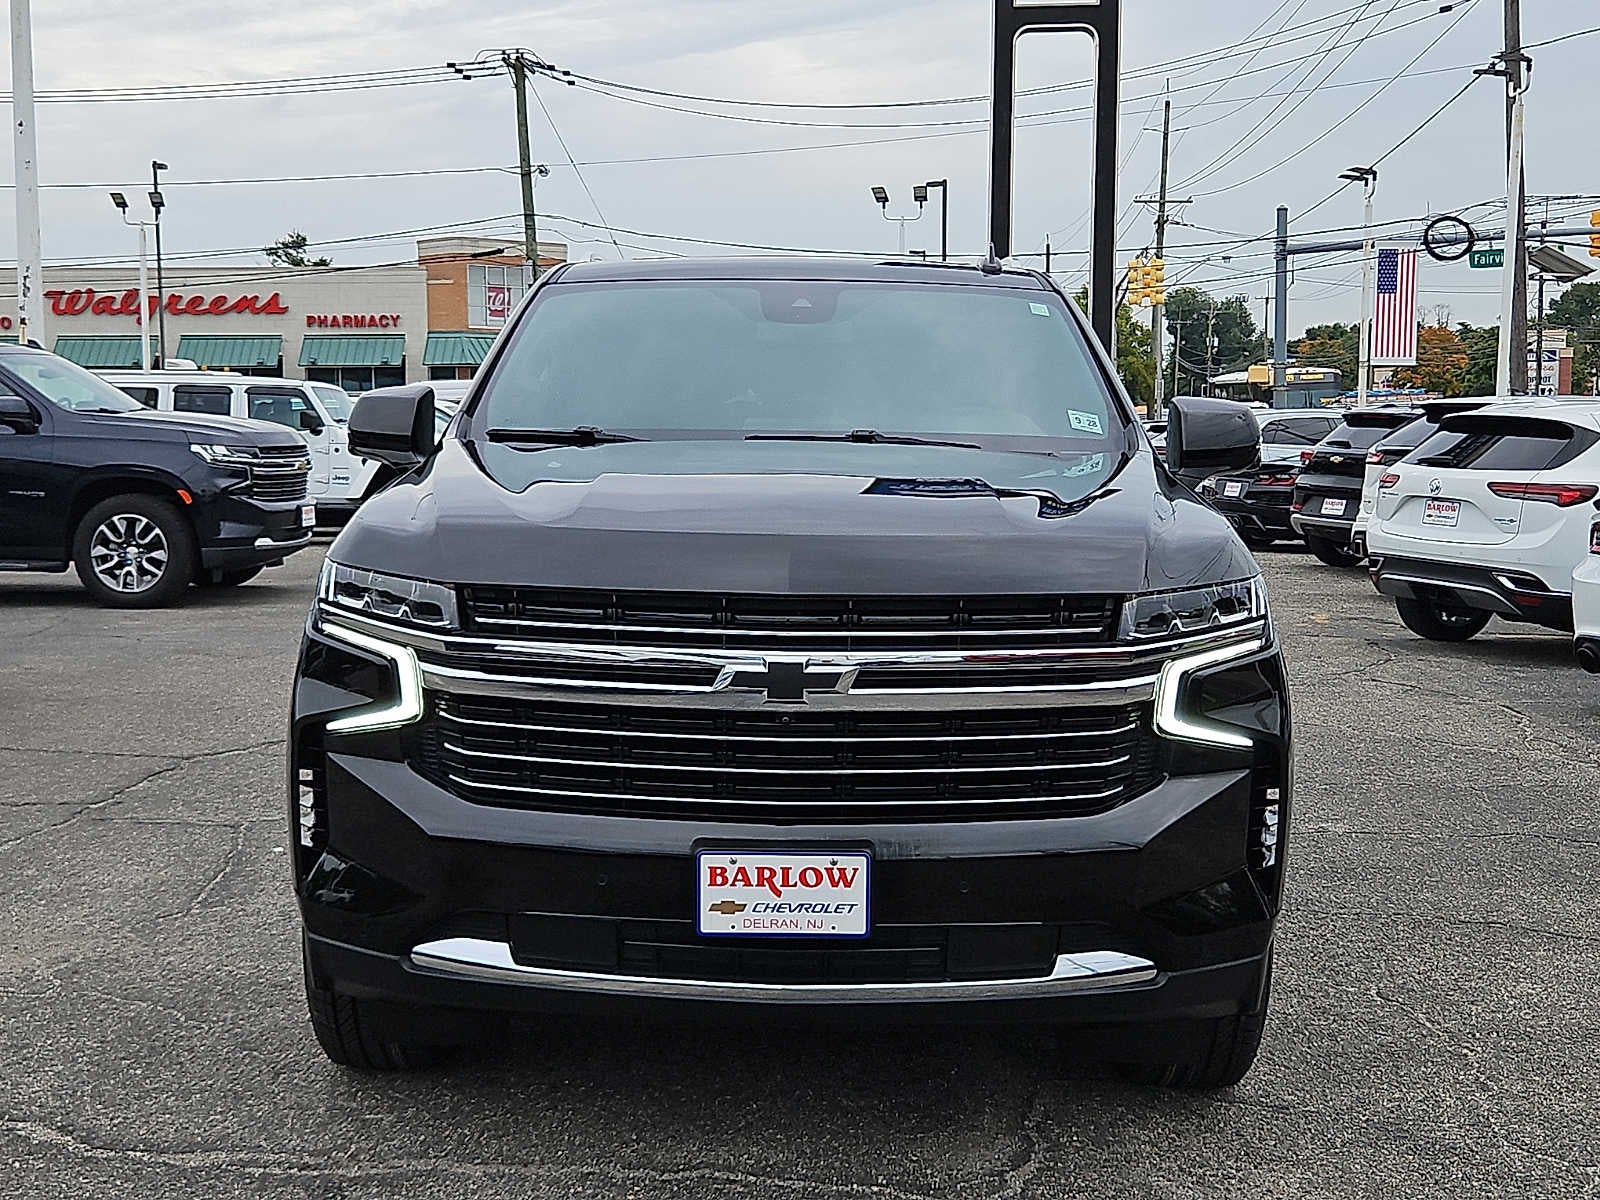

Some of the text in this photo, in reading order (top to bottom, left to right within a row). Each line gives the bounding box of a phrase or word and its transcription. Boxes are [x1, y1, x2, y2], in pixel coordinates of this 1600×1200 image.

[1474, 253, 1504, 264] Fairvi
[306, 314, 401, 328] PHARMACY
[1427, 503, 1457, 514] BARLOW
[707, 866, 859, 898] BARLOW
[752, 903, 858, 914] CHEVROLET
[743, 918, 824, 930] DELRAN, NJ
